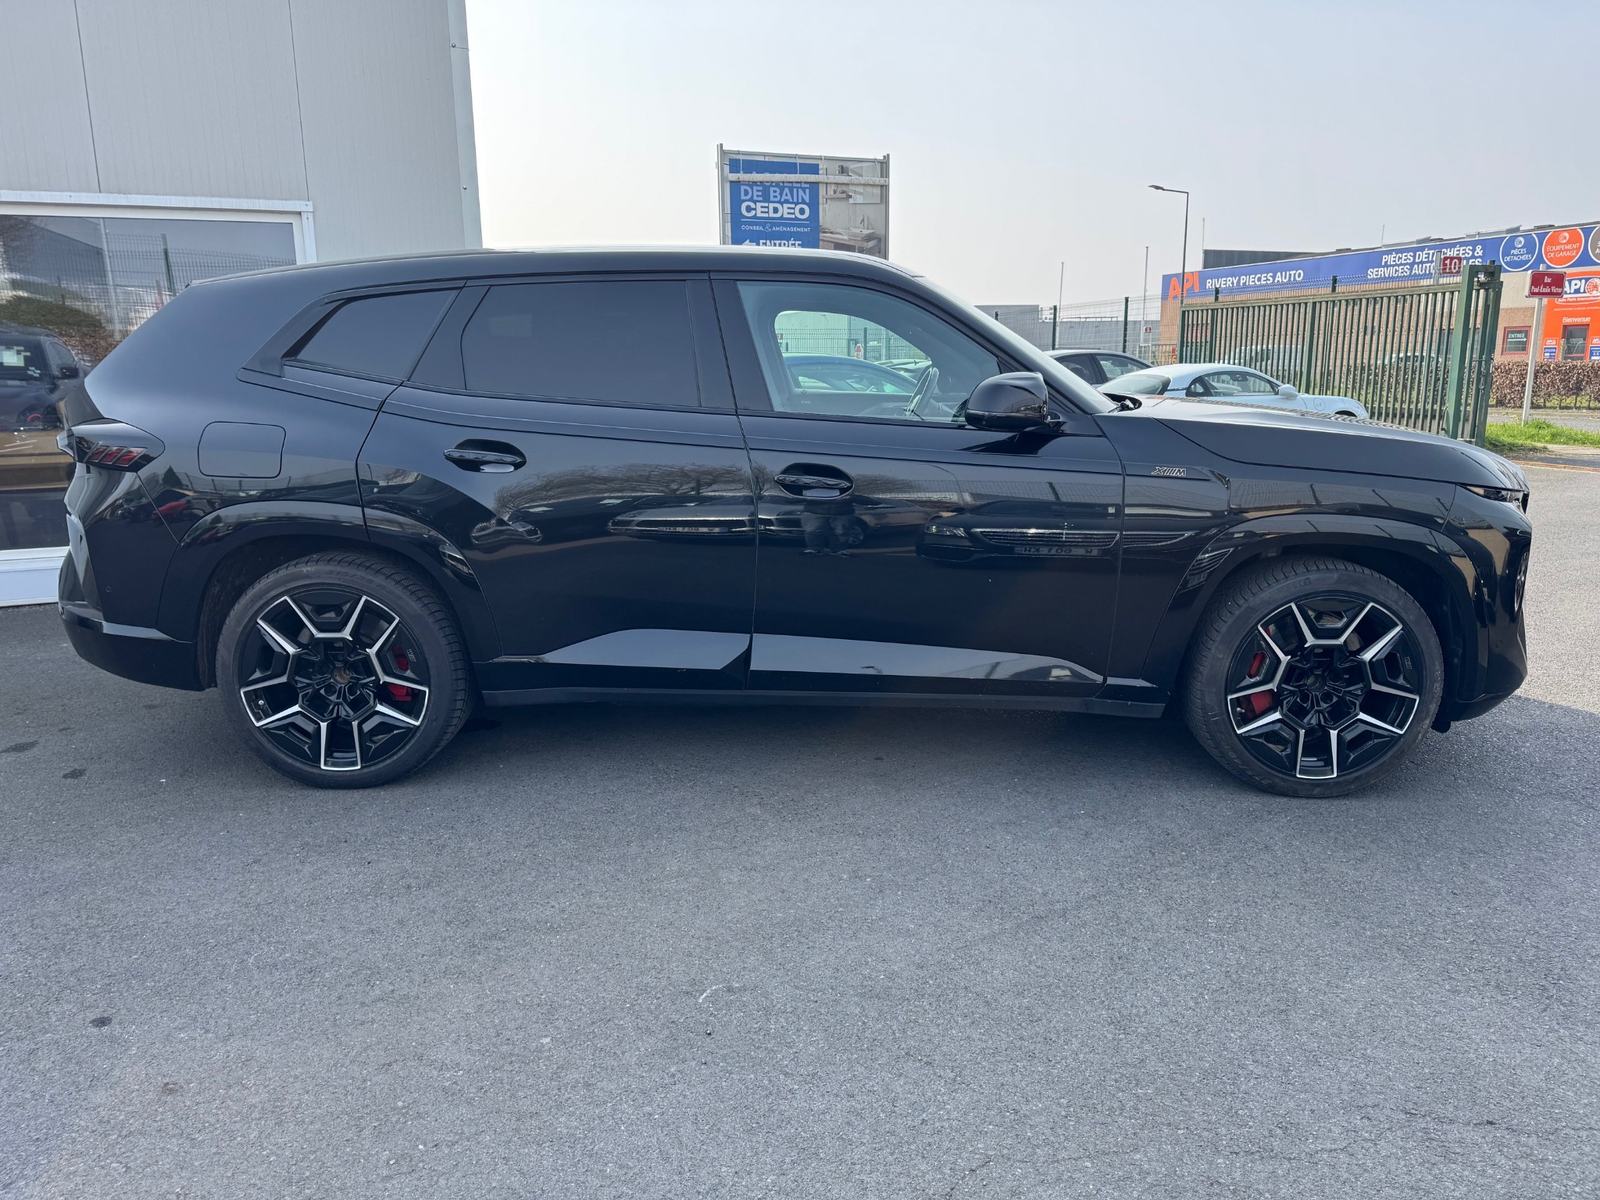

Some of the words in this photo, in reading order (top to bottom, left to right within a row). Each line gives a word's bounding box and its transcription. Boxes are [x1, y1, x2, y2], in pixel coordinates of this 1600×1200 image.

[740, 185, 763, 201] DE
[769, 187, 810, 203] BAIN
[741, 201, 810, 219] CEDEO
[1381, 252, 1413, 266] PIÈCES
[1474, 245, 1483, 256] &
[1367, 265, 1410, 279] SERVICES
[1444, 258, 1460, 273] 10
[1168, 271, 1200, 303] API
[1206, 275, 1239, 290] RIVERY
[1240, 272, 1273, 286] PIECES
[1275, 269, 1303, 282] AUTO
